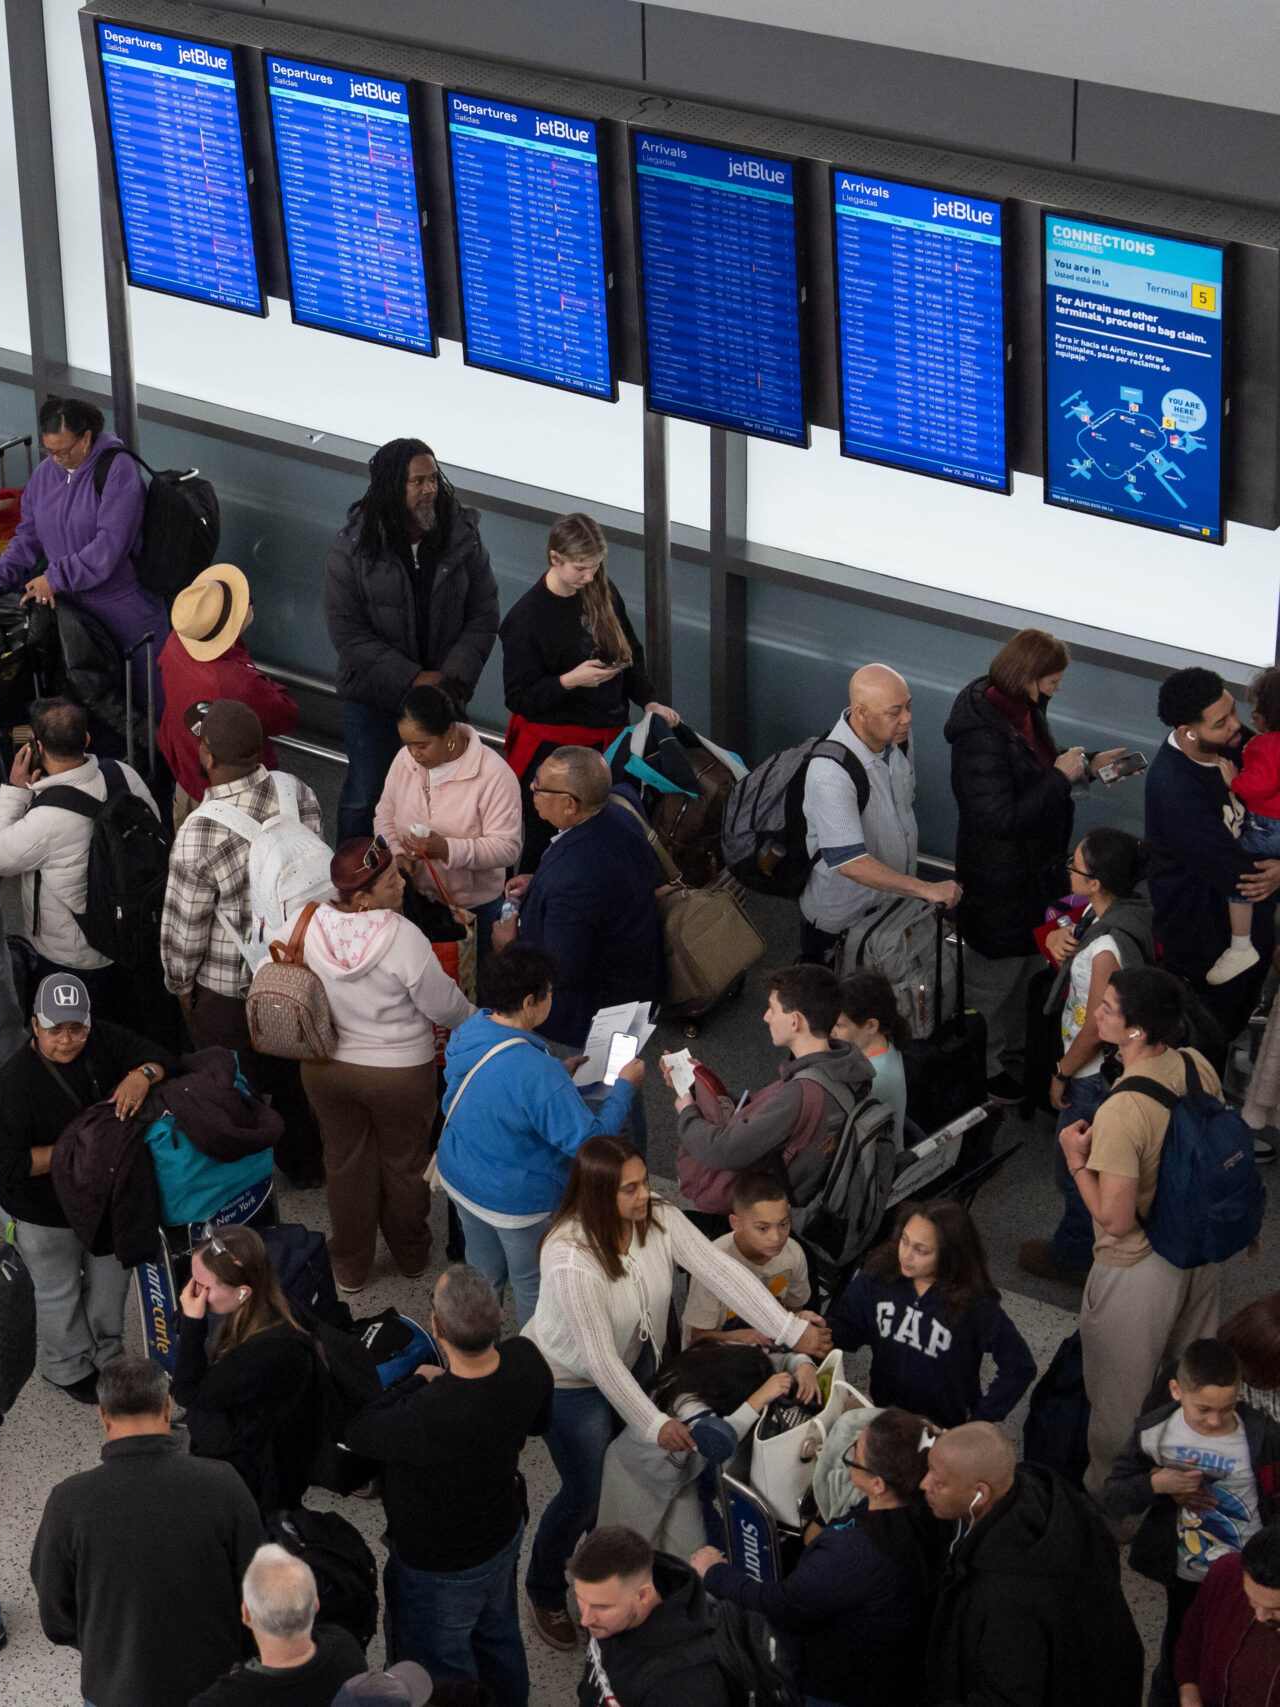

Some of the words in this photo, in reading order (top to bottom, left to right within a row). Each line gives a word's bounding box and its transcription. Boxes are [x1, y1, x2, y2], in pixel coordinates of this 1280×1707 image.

[104, 29, 162, 52] Departures
[105, 42, 129, 54] Salidas
[177, 45, 227, 74] jetBlue
[271, 62, 333, 86] Departures
[273, 76, 298, 88] Salidas
[348, 78, 401, 108] jetBlue
[453, 99, 517, 123] Departures
[454, 112, 479, 125] Salidas
[534, 116, 589, 147] jetBlue
[641, 140, 687, 159] Arrivals
[642, 153, 676, 168] Llegadas
[727, 157, 785, 187] jetBlue
[841, 178, 889, 199] Arrivals
[842, 193, 878, 208] Llegadas
[931, 197, 992, 229] jetBlue
[1052, 236, 1103, 254] CONEXIONES
[1053, 224, 1155, 256] CONNECTIONS
[1054, 258, 1071, 270] You
[1073, 263, 1089, 273] are
[1091, 266, 1100, 275] in
[1054, 270, 1074, 280] Usted
[1076, 274, 1090, 284] está
[1102, 280, 1109, 288] la
[209, 292, 219, 300] Mar
[1146, 282, 1188, 299] Terminal
[1199, 291, 1207, 304] 5
[1055, 293, 1072, 305] For
[1073, 297, 1111, 313] Airtrain
[1112, 305, 1130, 317] and
[1132, 310, 1158, 323] other
[1055, 304, 1104, 323] terminals,
[1106, 315, 1144, 332] proceed
[1146, 324, 1155, 333] to
[1158, 326, 1175, 339] bag
[1177, 329, 1206, 344] claim.
[1055, 333, 1072, 344] Para
[1073, 337, 1079, 345] ir
[1081, 339, 1099, 349] hacia
[1101, 343, 1107, 351] el
[1109, 345, 1137, 358] Airtrain
[1144, 353, 1163, 363] otras
[1055, 349, 1087, 363] equipaje.
[1055, 341, 1095, 357] terminales,
[1097, 351, 1114, 361] pase
[1116, 355, 1128, 364] por
[1129, 357, 1159, 370] reclamo
[1161, 363, 1170, 372] de
[555, 374, 564, 382] Mar
[1168, 397, 1181, 405] YOU
[1184, 400, 1200, 409] ARE
[1174, 405, 1193, 415] HERE
[743, 420, 755, 428] Mar
[1166, 419, 1171, 427] 5
[943, 466, 952, 474] Mar
[216, 1211, 237, 1226] New
[238, 1196, 256, 1212] York
[220, 1194, 244, 1213] Welcome
[876, 1302, 952, 1358] GAP
[1176, 1446, 1236, 1472] SONIC
